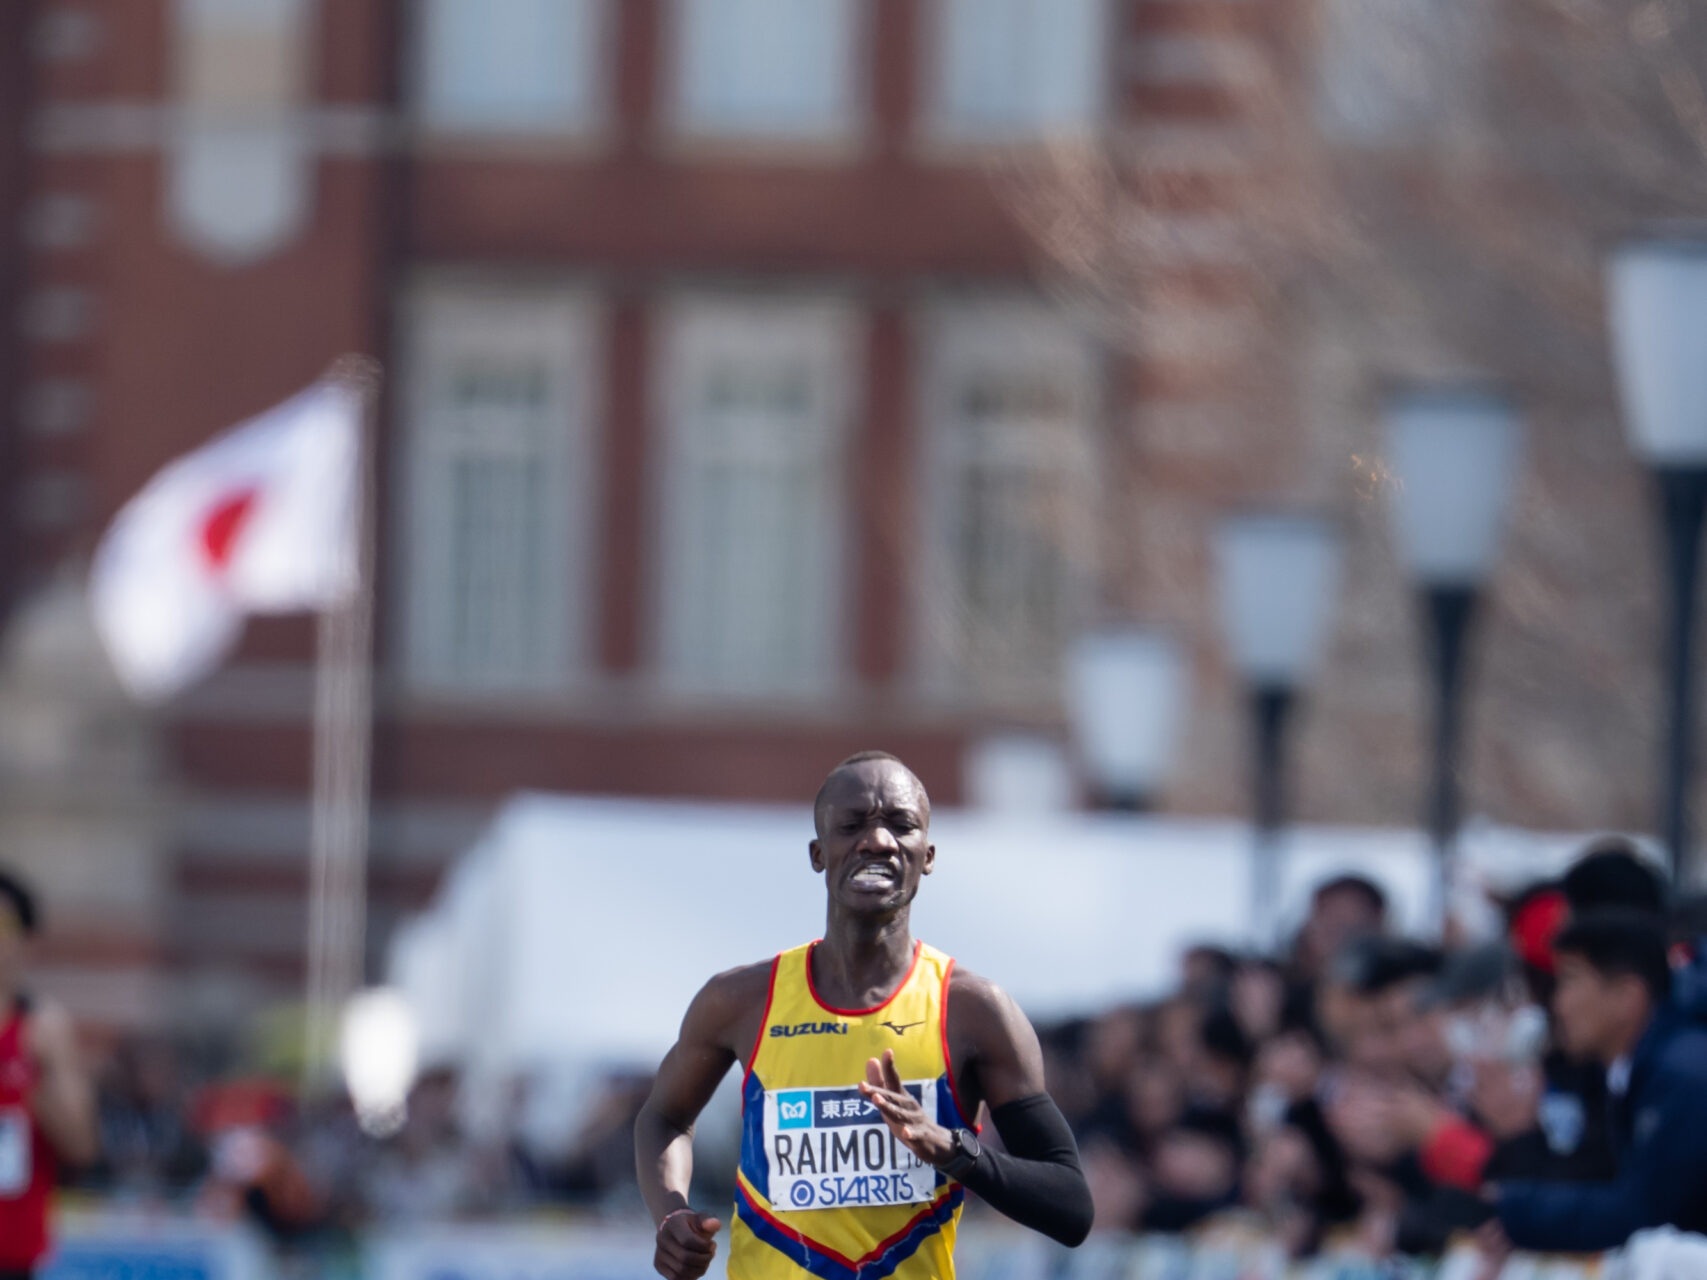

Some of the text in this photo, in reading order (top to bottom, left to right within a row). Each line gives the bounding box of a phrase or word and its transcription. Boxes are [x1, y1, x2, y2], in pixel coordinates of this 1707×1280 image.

[769, 1022, 848, 1038] SUZUKI
[821, 1099, 879, 1119] 東京メ
